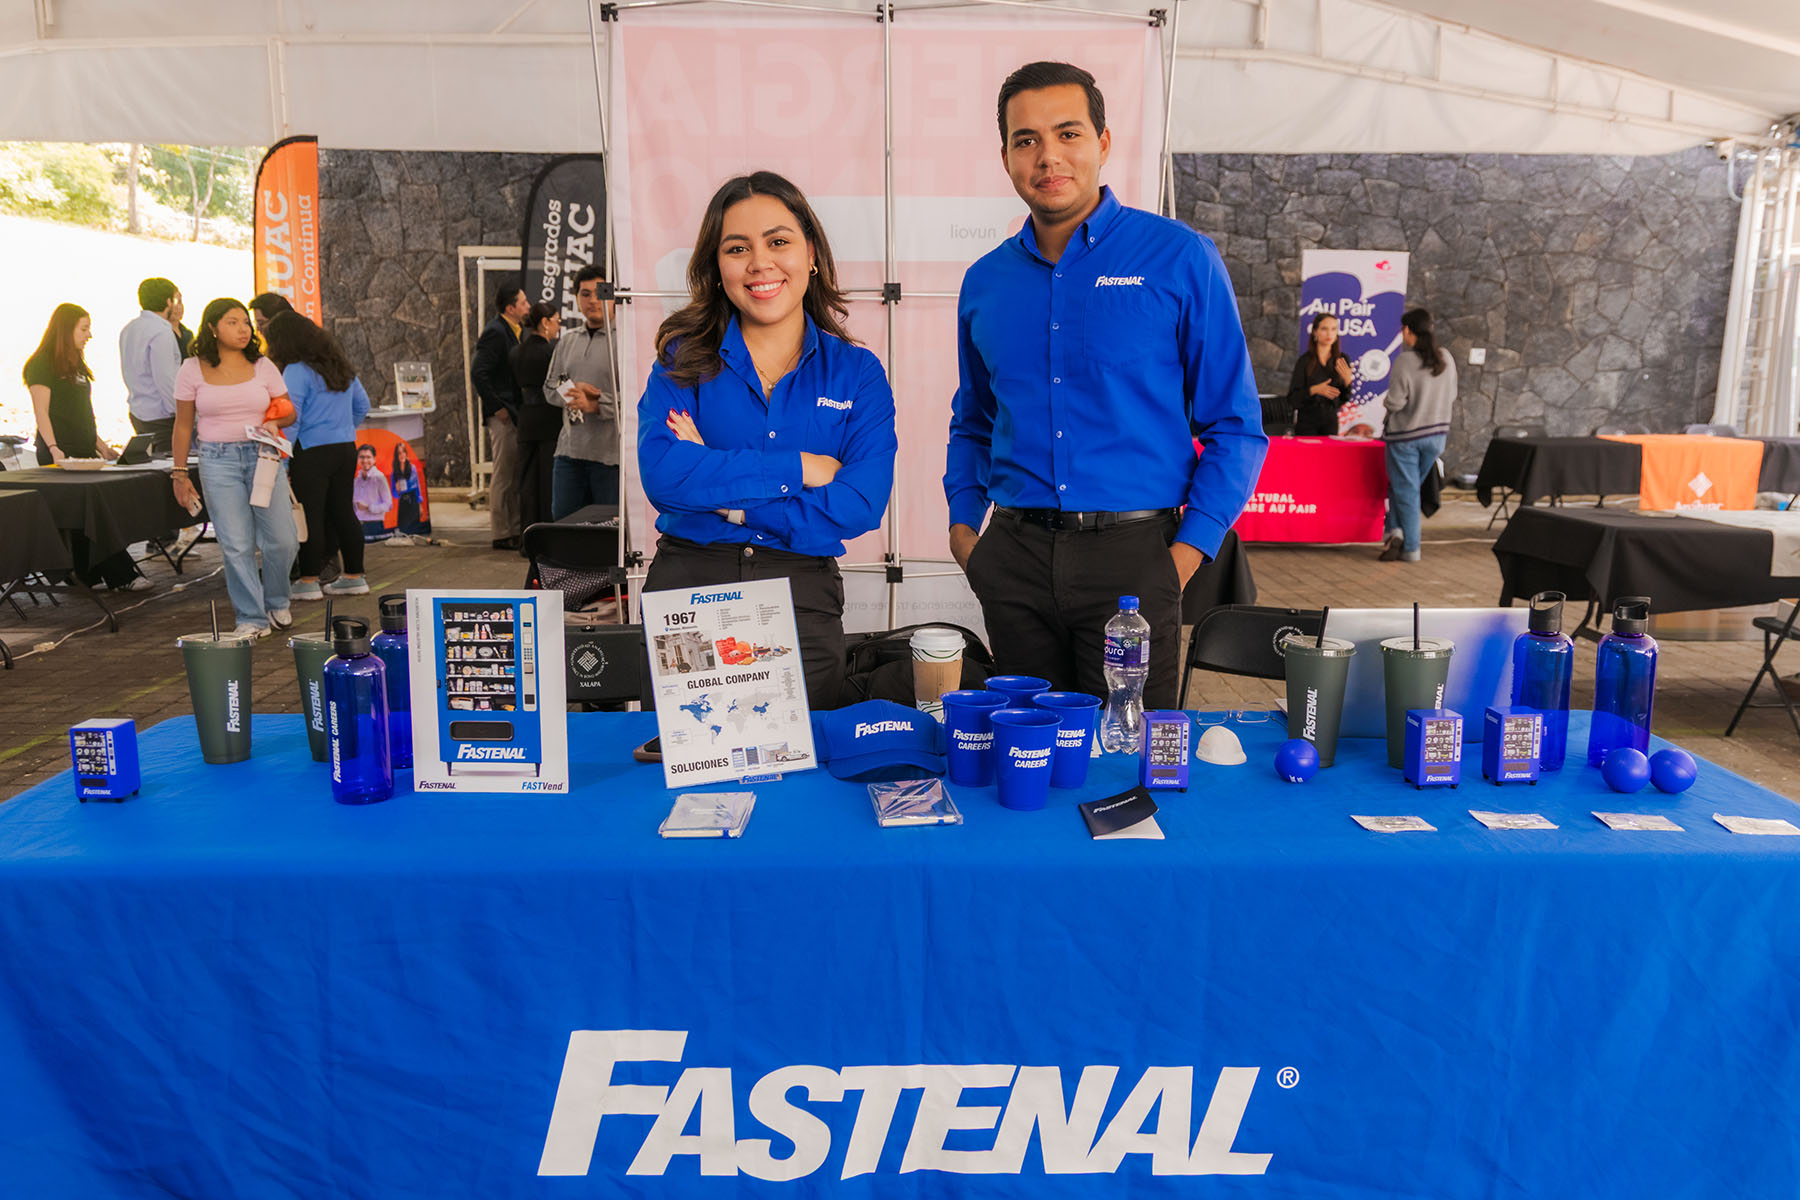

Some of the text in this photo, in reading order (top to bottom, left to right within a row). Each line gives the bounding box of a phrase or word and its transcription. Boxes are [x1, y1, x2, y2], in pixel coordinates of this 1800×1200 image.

[298, 195, 315, 295] Continua
[539, 199, 562, 303] osgrados
[1095, 275, 1144, 287] FASTENAL
[1308, 298, 1376, 316] Au Pair
[1337, 318, 1377, 337] USA
[1249, 493, 1295, 503] LTURAL
[1269, 503, 1286, 514] AU
[1289, 504, 1317, 514] PAIR
[690, 591, 744, 605] FASTENAL
[664, 611, 696, 626] 1967
[687, 677, 724, 690] GLOBAL
[725, 671, 771, 685] COMPANY
[227, 680, 240, 733] FASTENAL
[309, 679, 324, 733] FASTENAL
[1303, 686, 1318, 741] FASTENAL
[855, 720, 914, 739] FASTENAL
[953, 729, 994, 741] FASTENAL
[329, 700, 342, 784] FASTENAL CAREERS
[958, 741, 991, 750] CAREERS
[457, 744, 527, 760] FASTENAL
[1008, 746, 1051, 759] FASTENAL
[670, 757, 729, 775] SOLUCIONES
[1014, 758, 1048, 768] CAREERS
[419, 780, 456, 790] FASTENAL
[521, 781, 563, 791] FASTVend
[537, 1030, 1273, 1181] FASTENAL
